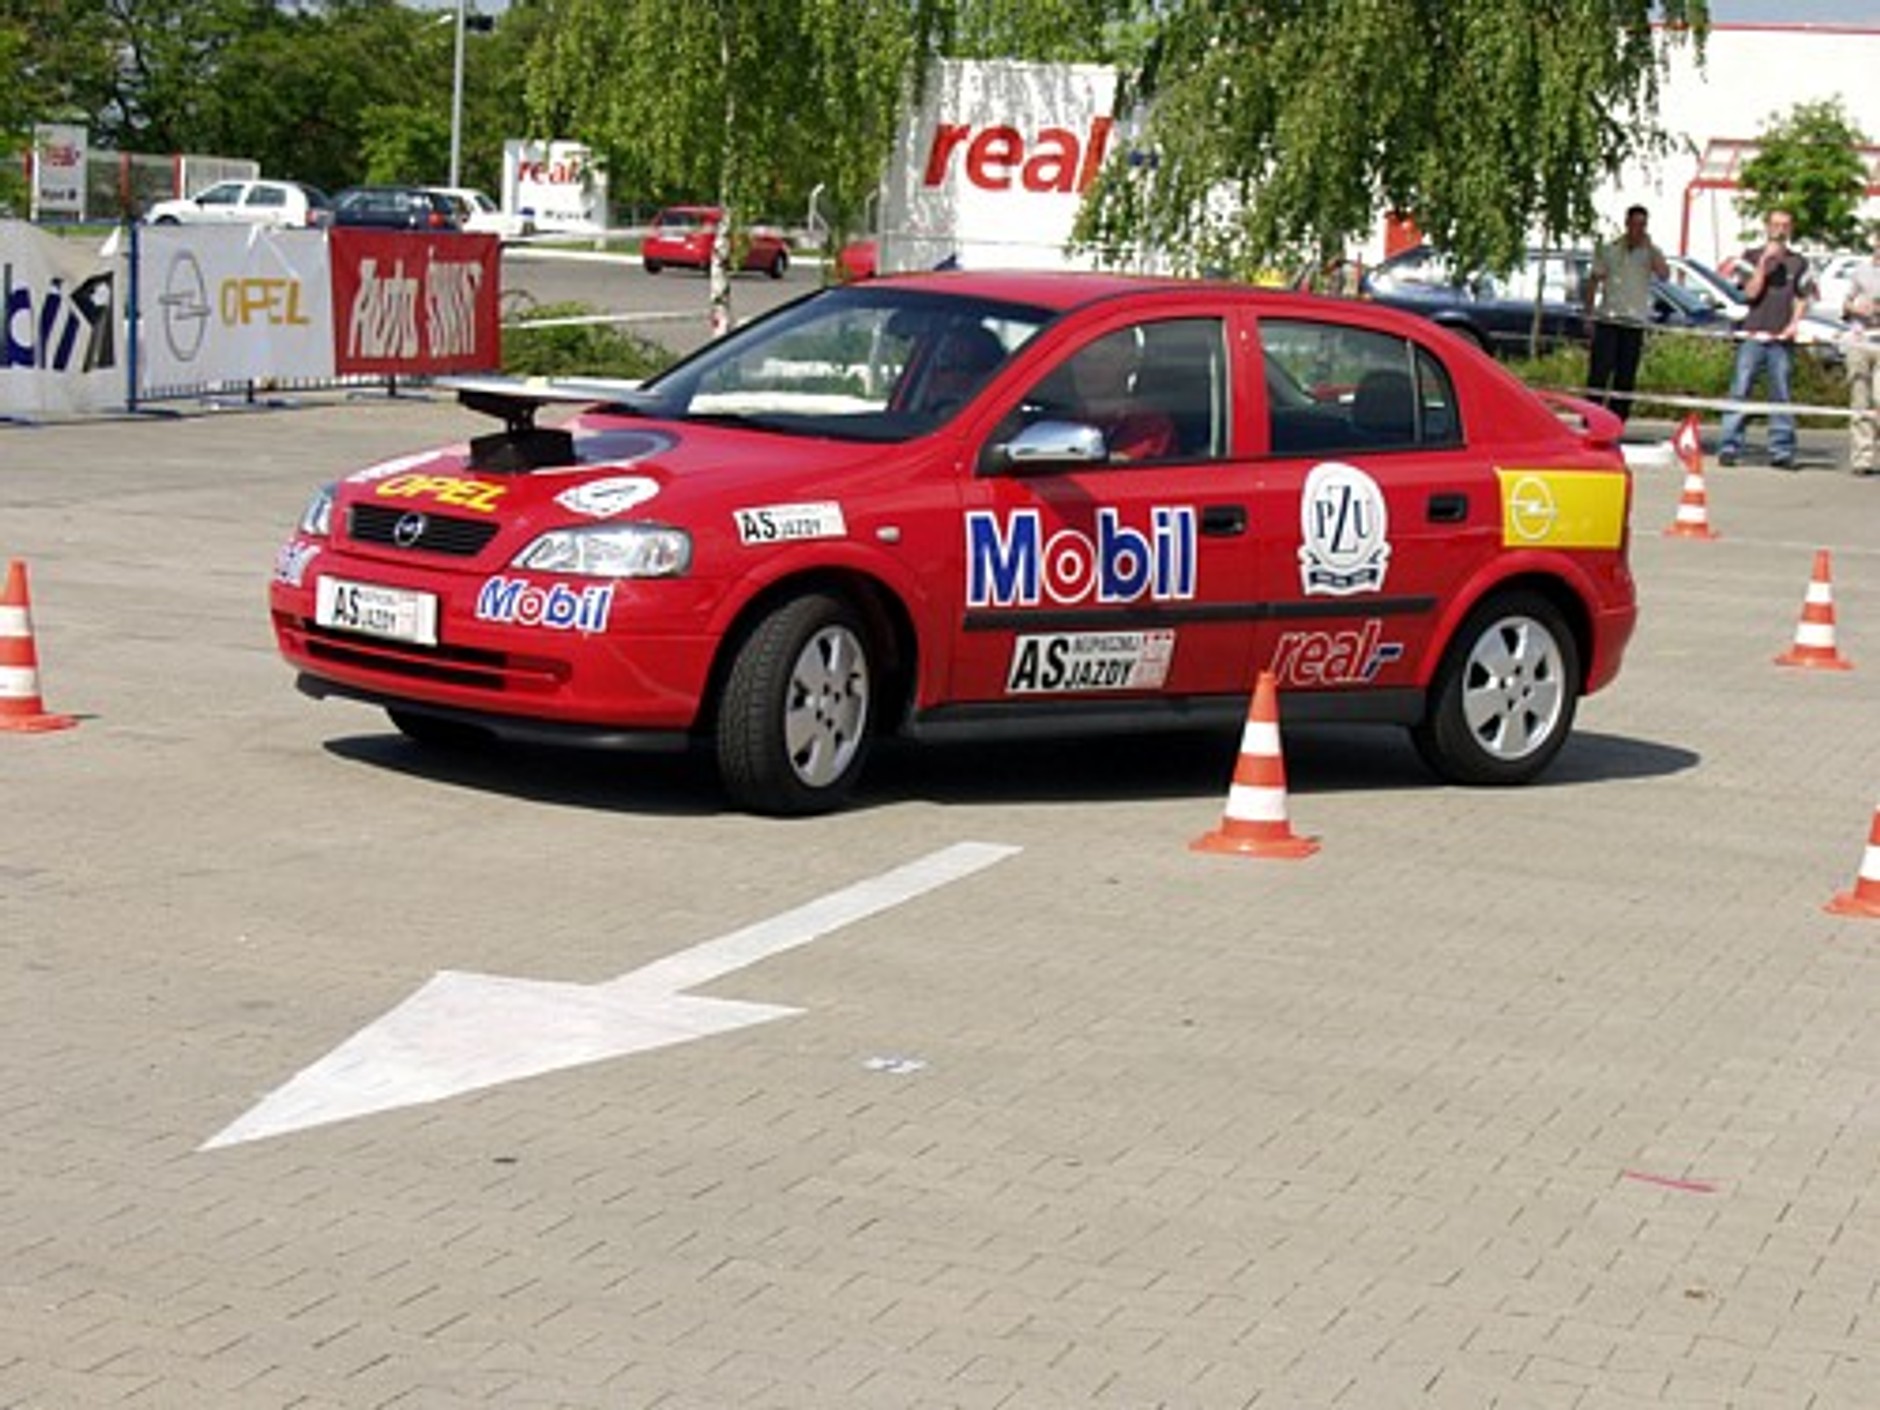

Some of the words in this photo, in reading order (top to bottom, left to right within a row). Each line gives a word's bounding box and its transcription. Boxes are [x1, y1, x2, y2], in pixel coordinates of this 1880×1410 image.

[220, 277, 310, 327] OPEL
[375, 463, 509, 512] OPEL
[740, 511, 776, 540] AS
[1315, 485, 1374, 554] PZU
[966, 506, 1197, 606] Mobil
[333, 586, 362, 626] AS
[476, 576, 614, 633] Mobil
[1010, 638, 1069, 690] AS
